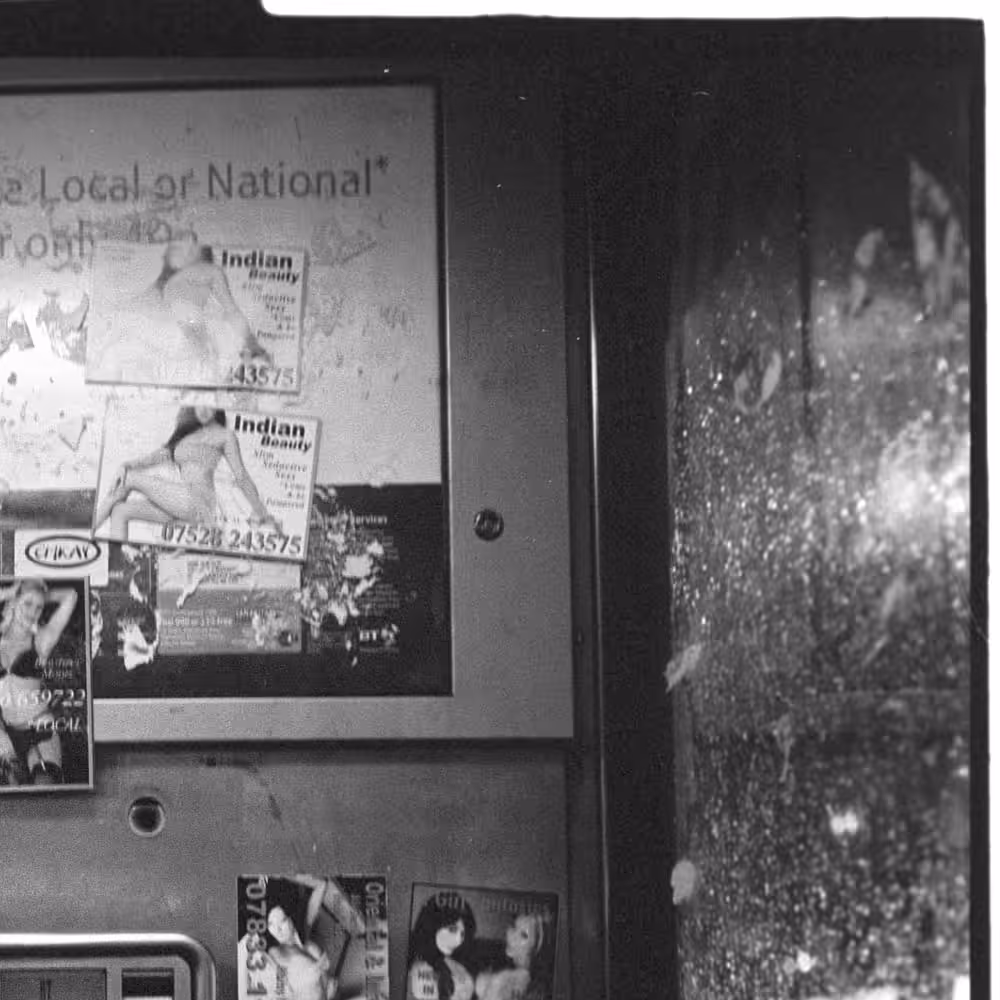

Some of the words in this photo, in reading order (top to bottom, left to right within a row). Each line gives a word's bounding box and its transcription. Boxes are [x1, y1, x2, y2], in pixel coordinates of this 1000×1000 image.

[39, 162, 140, 203] Local
[152, 170, 195, 201] or
[222, 250, 293, 269] Indian
[249, 269, 300, 285] Beauty
[230, 364, 297, 386] 43575
[234, 415, 306, 437] Indian
[260, 436, 312, 453] Beauty
[228, 529, 303, 556] 243575
